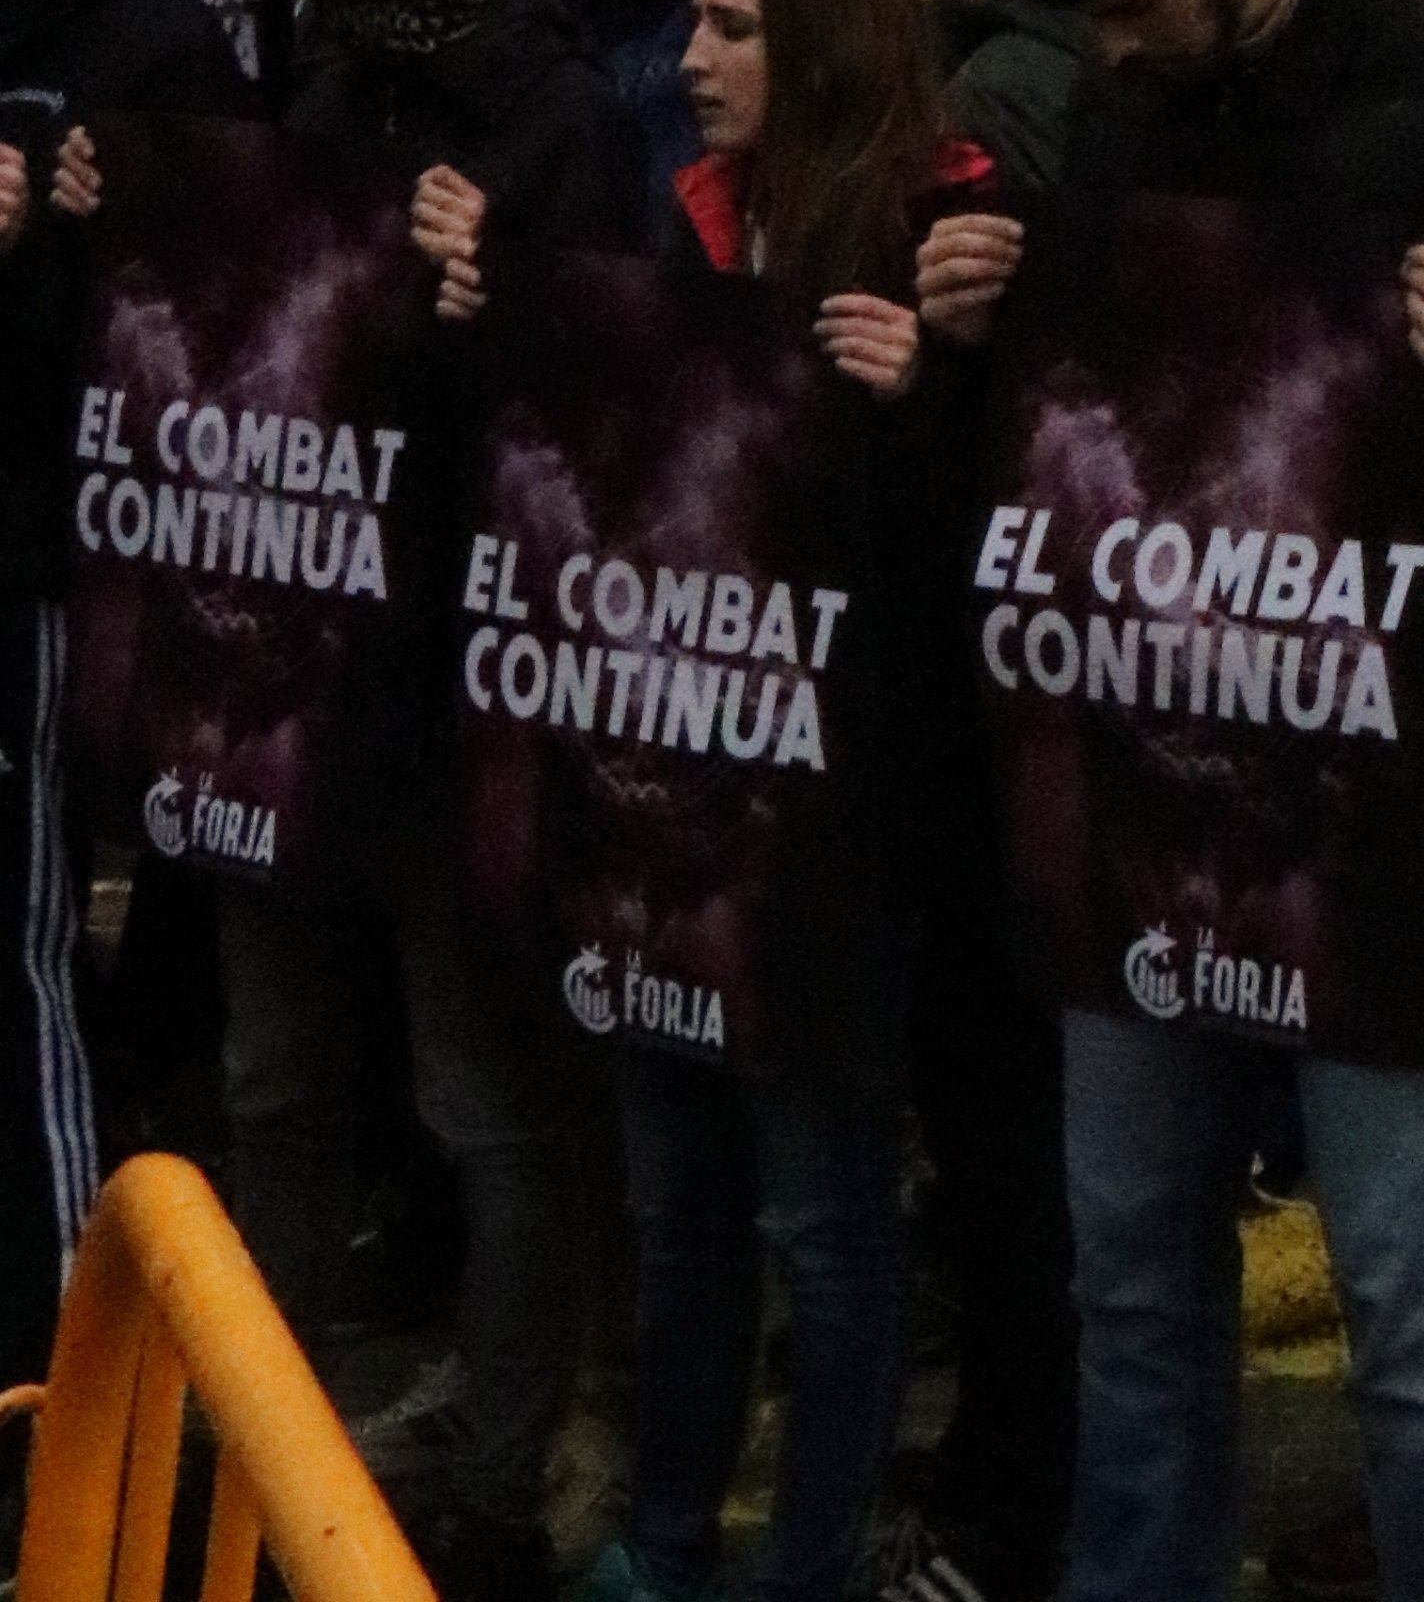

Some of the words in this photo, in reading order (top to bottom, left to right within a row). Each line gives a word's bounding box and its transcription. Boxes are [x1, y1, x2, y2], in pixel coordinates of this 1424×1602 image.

[76, 386, 133, 464] EL
[156, 400, 406, 504] COMBAT
[76, 472, 387, 601] CONTINUA
[974, 505, 1056, 594] EL
[463, 534, 529, 620] EL
[557, 552, 850, 669] COMBAT
[464, 626, 826, 771] CONTINUA
[982, 604, 1398, 740] CONTINUA
[192, 793, 276, 867] FORJA
[624, 971, 724, 1047] FORJA
[1194, 950, 1306, 1029] FORJA
